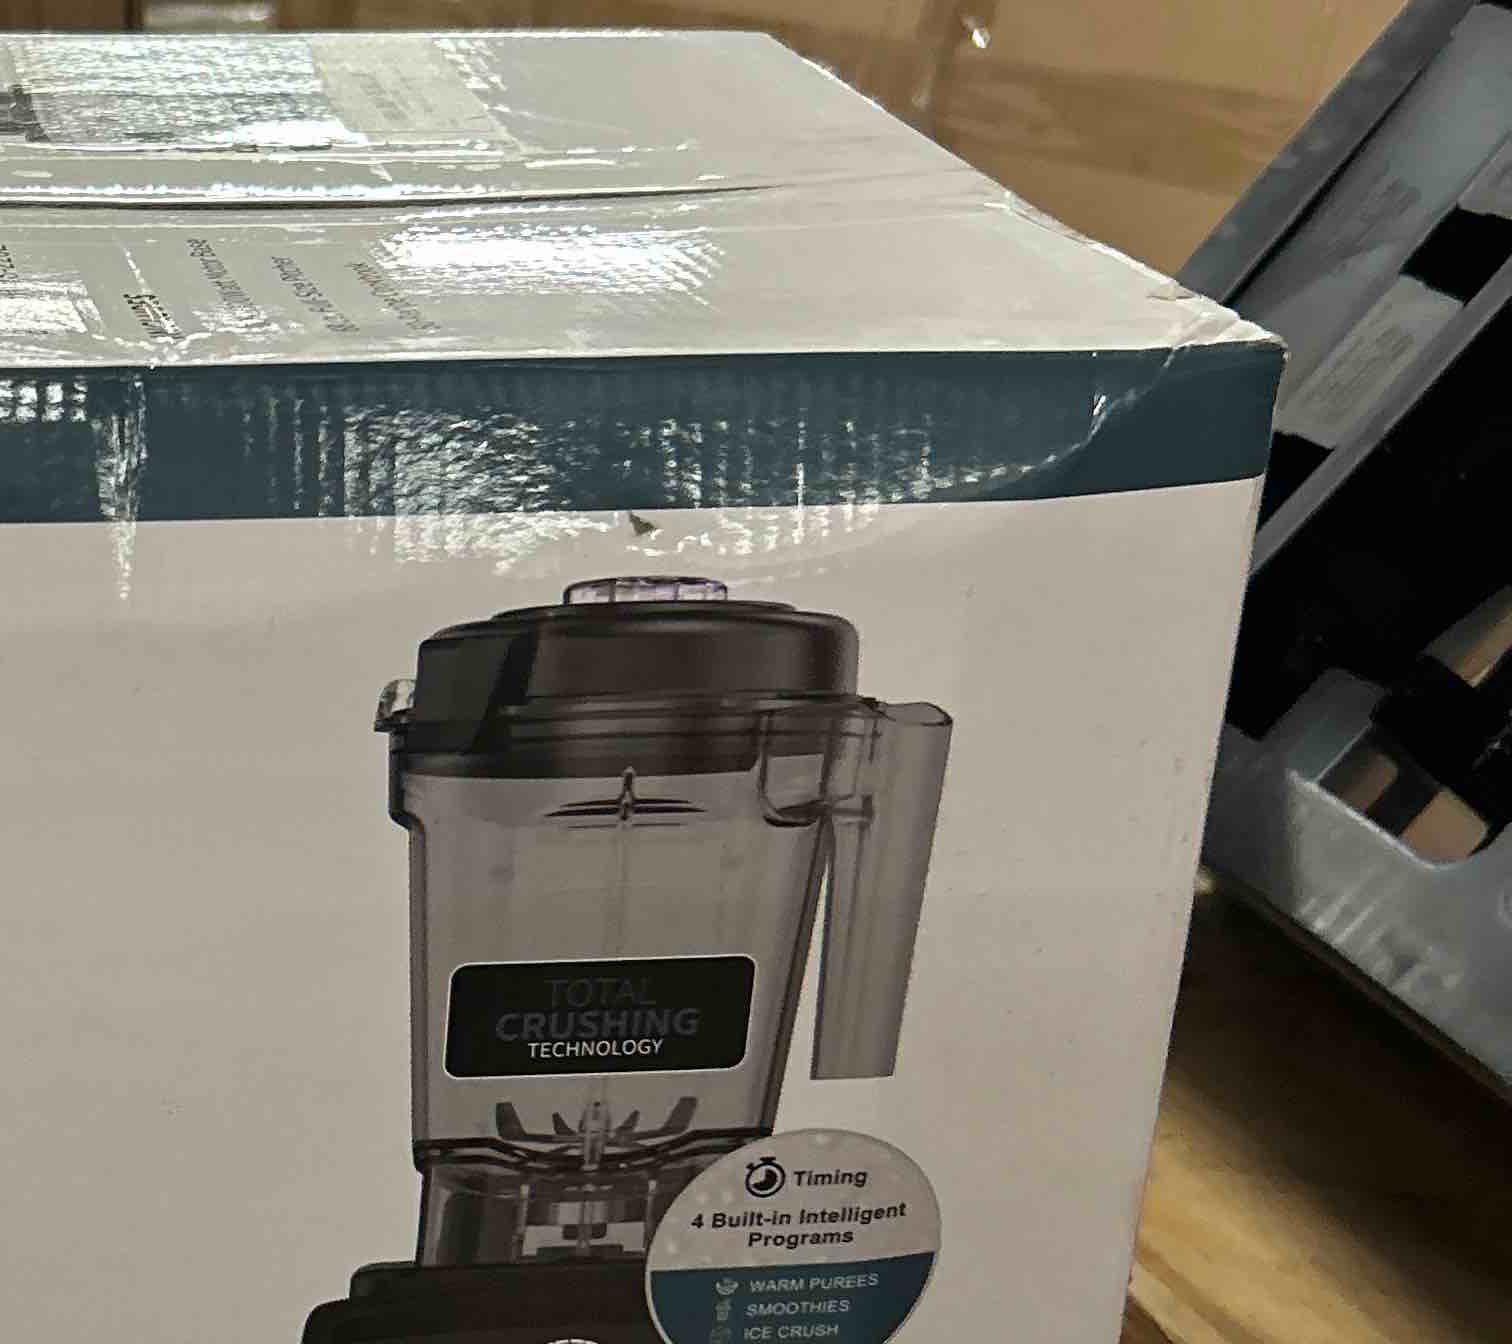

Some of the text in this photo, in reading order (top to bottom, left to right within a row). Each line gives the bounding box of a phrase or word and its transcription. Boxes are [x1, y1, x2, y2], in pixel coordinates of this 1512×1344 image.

[544, 976, 657, 1007] TOTAL
[495, 1008, 701, 1042] CRUSHING
[528, 1038, 664, 1058] TECHNOLOGY
[793, 1169, 868, 1188] Timing
[691, 1202, 908, 1229] 4 Built-in Intelligent
[748, 1230, 855, 1251] Programs
[749, 1273, 879, 1292] WARM PUREES
[746, 1299, 851, 1317] SMOOTHIES
[743, 1324, 839, 1340] ICE CRUSH
